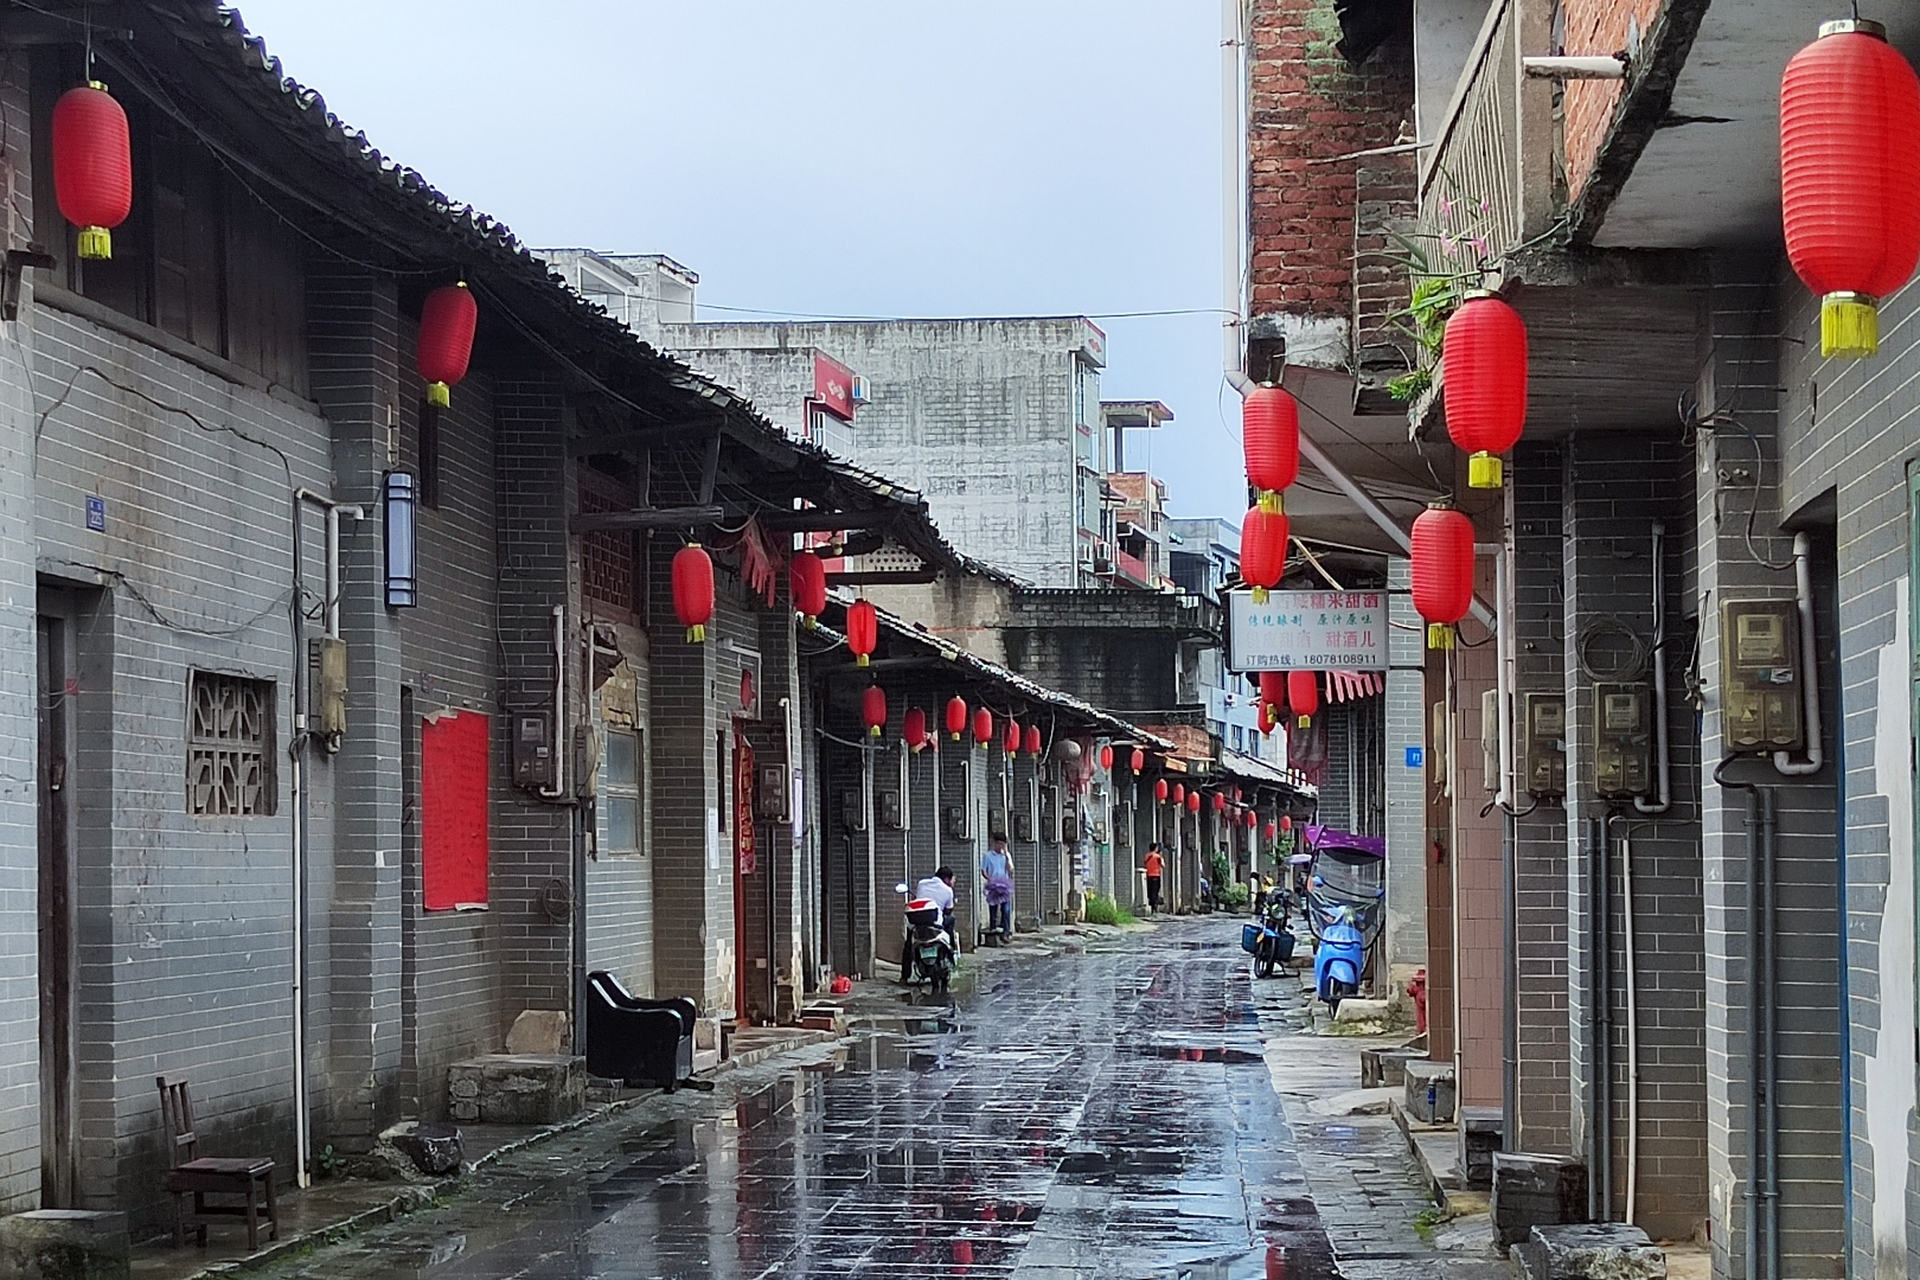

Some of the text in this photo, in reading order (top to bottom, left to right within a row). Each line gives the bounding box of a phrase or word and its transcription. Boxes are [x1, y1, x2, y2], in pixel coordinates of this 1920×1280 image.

[1325, 630, 1376, 649] 甜酒儿
[1303, 653, 1377, 665] 18078108911
